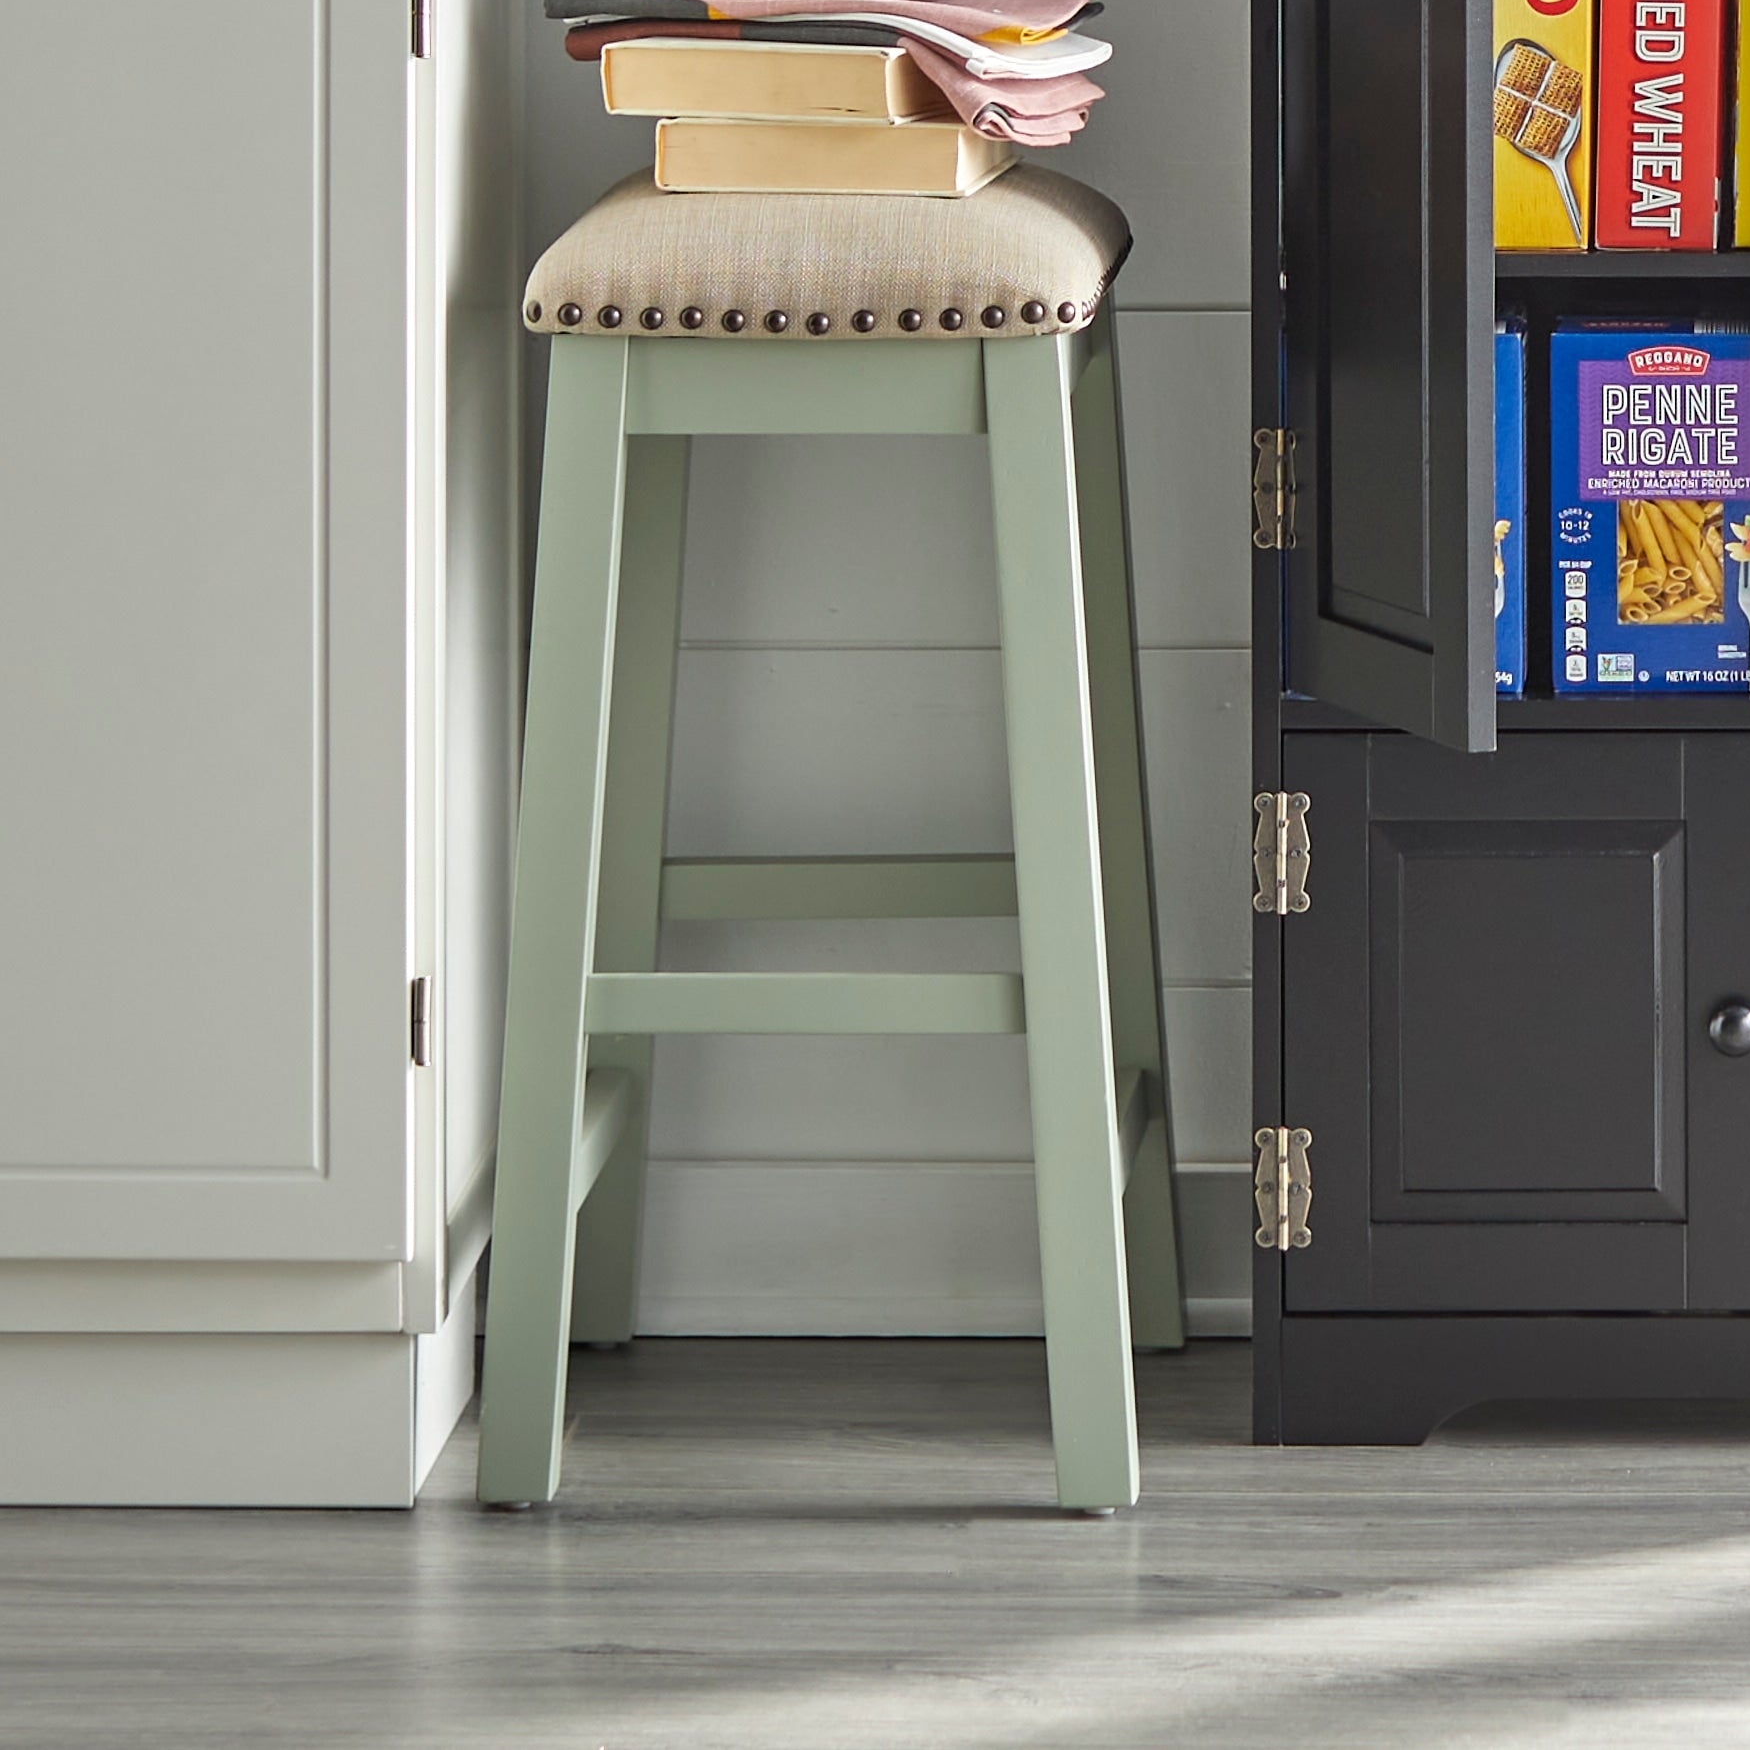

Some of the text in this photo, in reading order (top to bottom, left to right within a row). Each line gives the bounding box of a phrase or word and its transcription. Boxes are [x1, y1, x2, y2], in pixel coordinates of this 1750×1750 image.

[1631, 73, 1685, 238] WHEAT
[1635, 351, 1704, 368] REGGANO
[1602, 384, 1739, 425] PENNE
[1602, 428, 1739, 465] RIGATE
[1608, 470, 1631, 478] MADE
[1633, 470, 1656, 478] FROM
[1588, 478, 1750, 489] ENRICHED MACARONI PRODUCT
[1567, 574, 1584, 585] 200
[1665, 671, 1683, 682] NET
[1684, 671, 1700, 682] WT
[1702, 671, 1714, 682] 16
[1715, 671, 1729, 682] OZ
